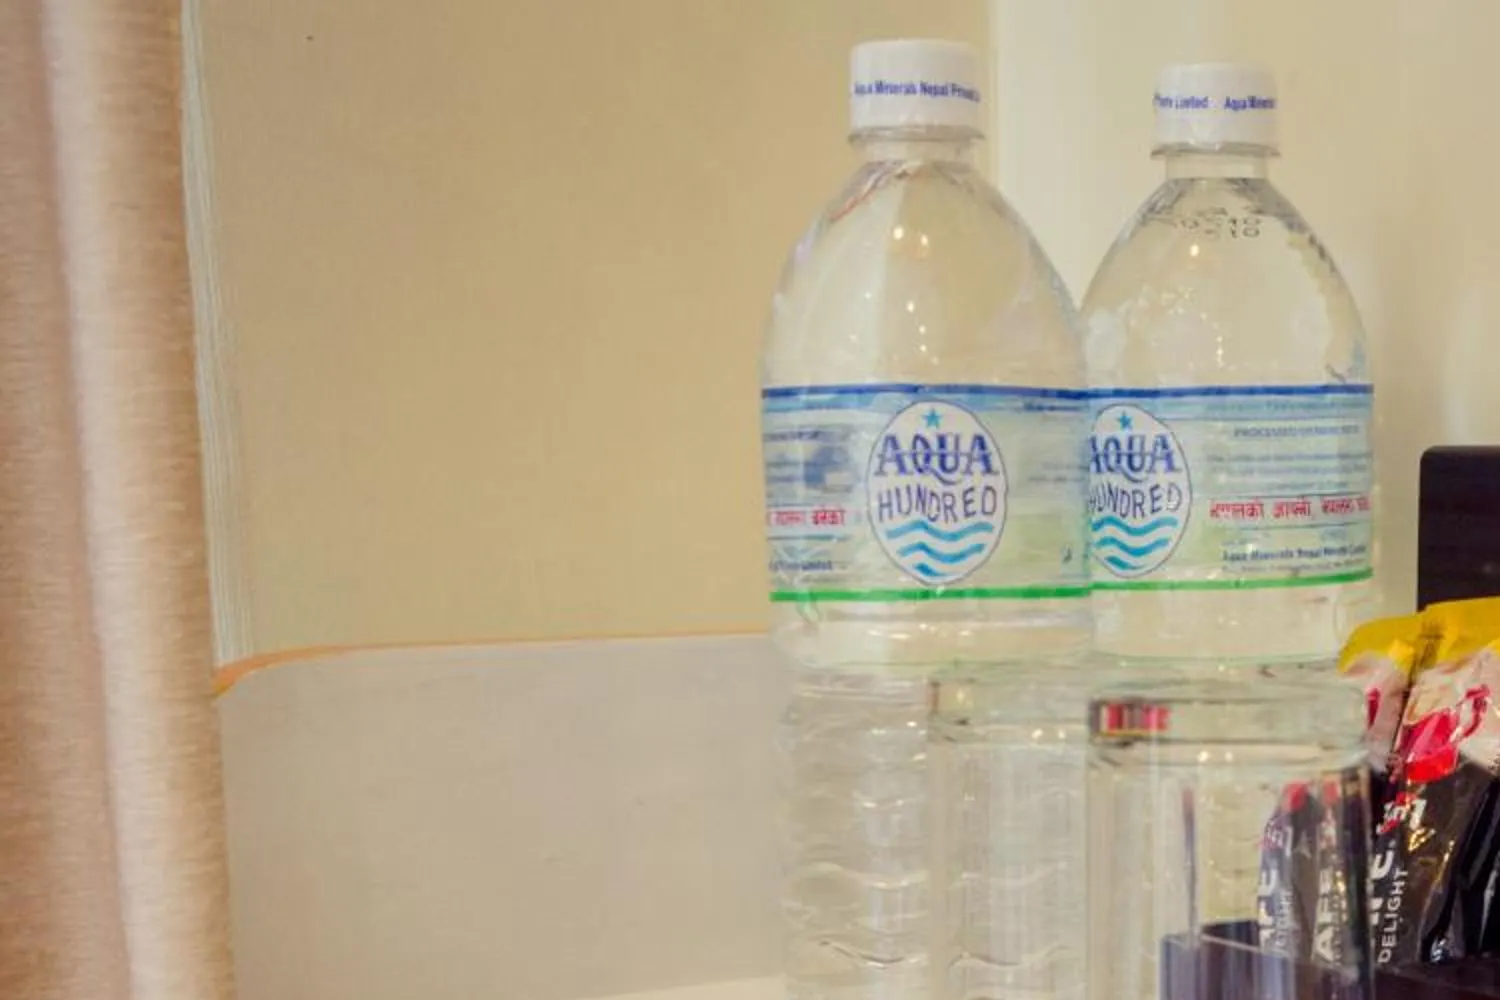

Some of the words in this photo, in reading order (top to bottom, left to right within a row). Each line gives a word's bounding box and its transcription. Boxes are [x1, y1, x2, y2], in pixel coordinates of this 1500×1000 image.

[874, 433, 999, 485] AQUA
[878, 483, 997, 523] HUNDRED
[1378, 867, 1409, 965] DELIGHT
